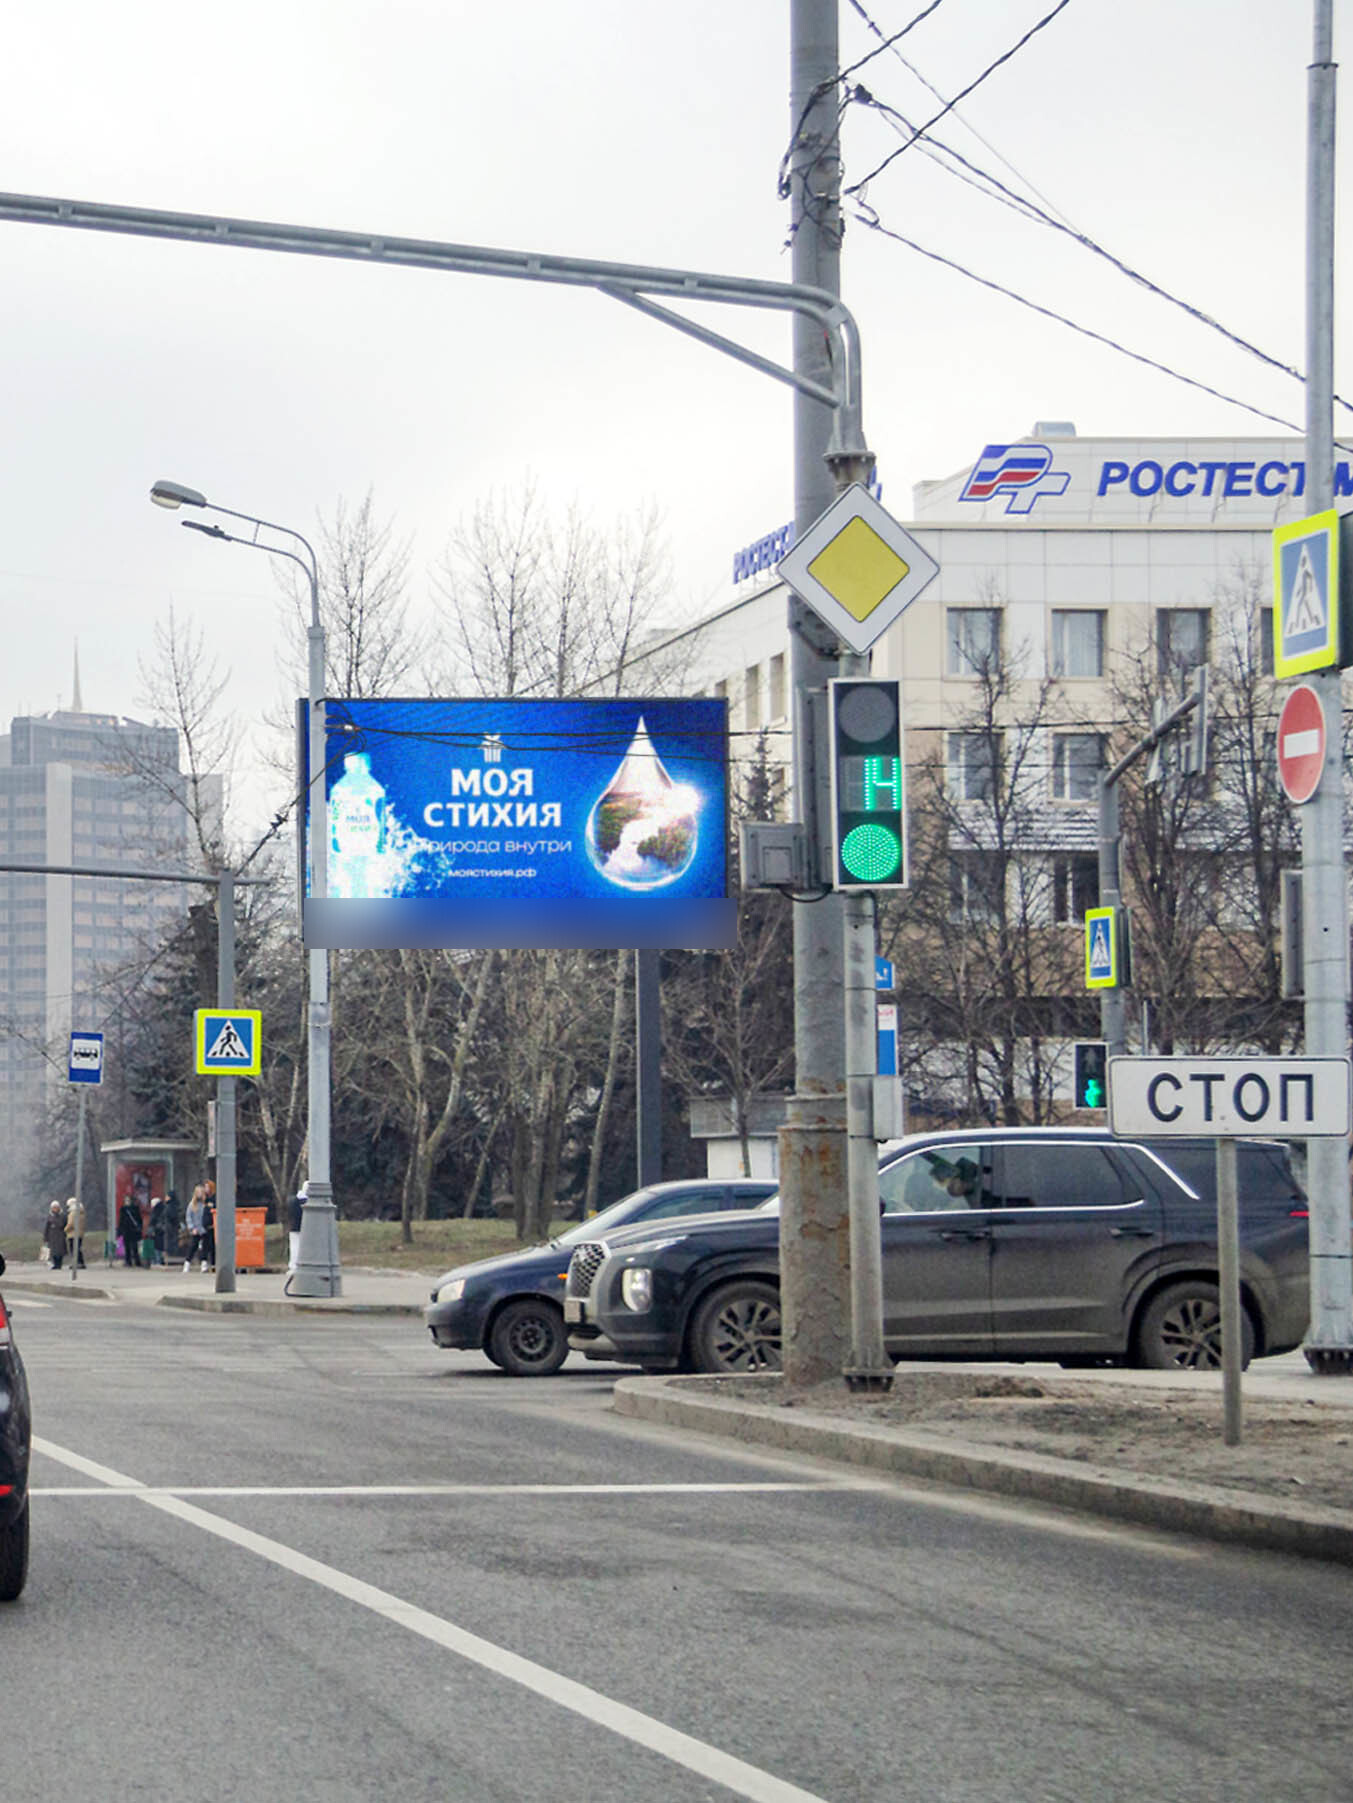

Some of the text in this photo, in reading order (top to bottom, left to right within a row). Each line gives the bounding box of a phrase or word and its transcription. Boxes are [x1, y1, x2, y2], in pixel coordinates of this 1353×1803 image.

[450, 768, 534, 797] МОЯ
[863, 756, 901, 811] 14
[423, 802, 561, 827] СТИХИЯ
[504, 840, 573, 855] внутри
[1147, 1072, 1315, 1123] СТОП
